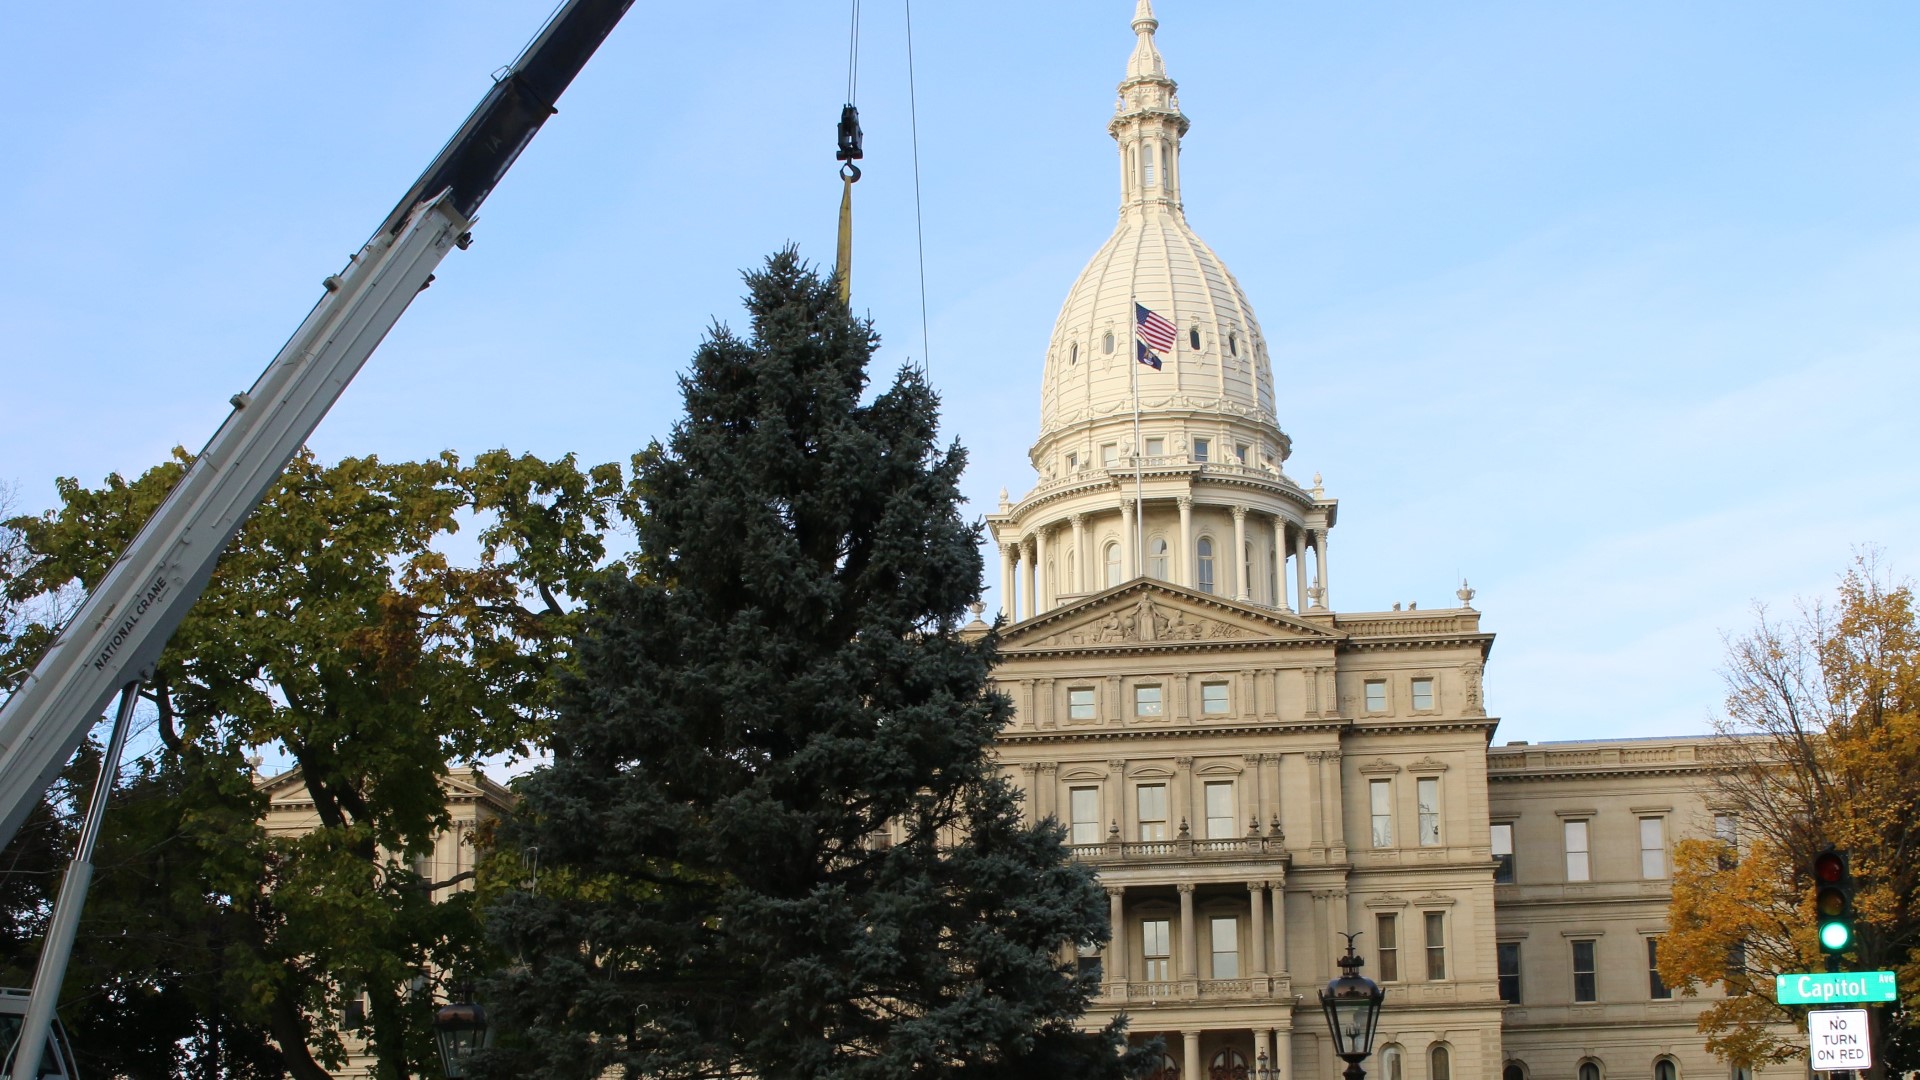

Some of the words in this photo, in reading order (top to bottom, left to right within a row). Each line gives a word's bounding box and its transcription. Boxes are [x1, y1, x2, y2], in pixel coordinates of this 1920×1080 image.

[94, 616, 139, 671] NATIONAL
[136, 576, 167, 615] CRANE
[1798, 975, 1867, 1001] Capitol
[1878, 974, 1895, 984] Ave
[1829, 1019, 1847, 1030] NO
[1822, 1034, 1857, 1045] TURN
[1817, 1049, 1835, 1060] ON
[1840, 1048, 1864, 1060] RED
